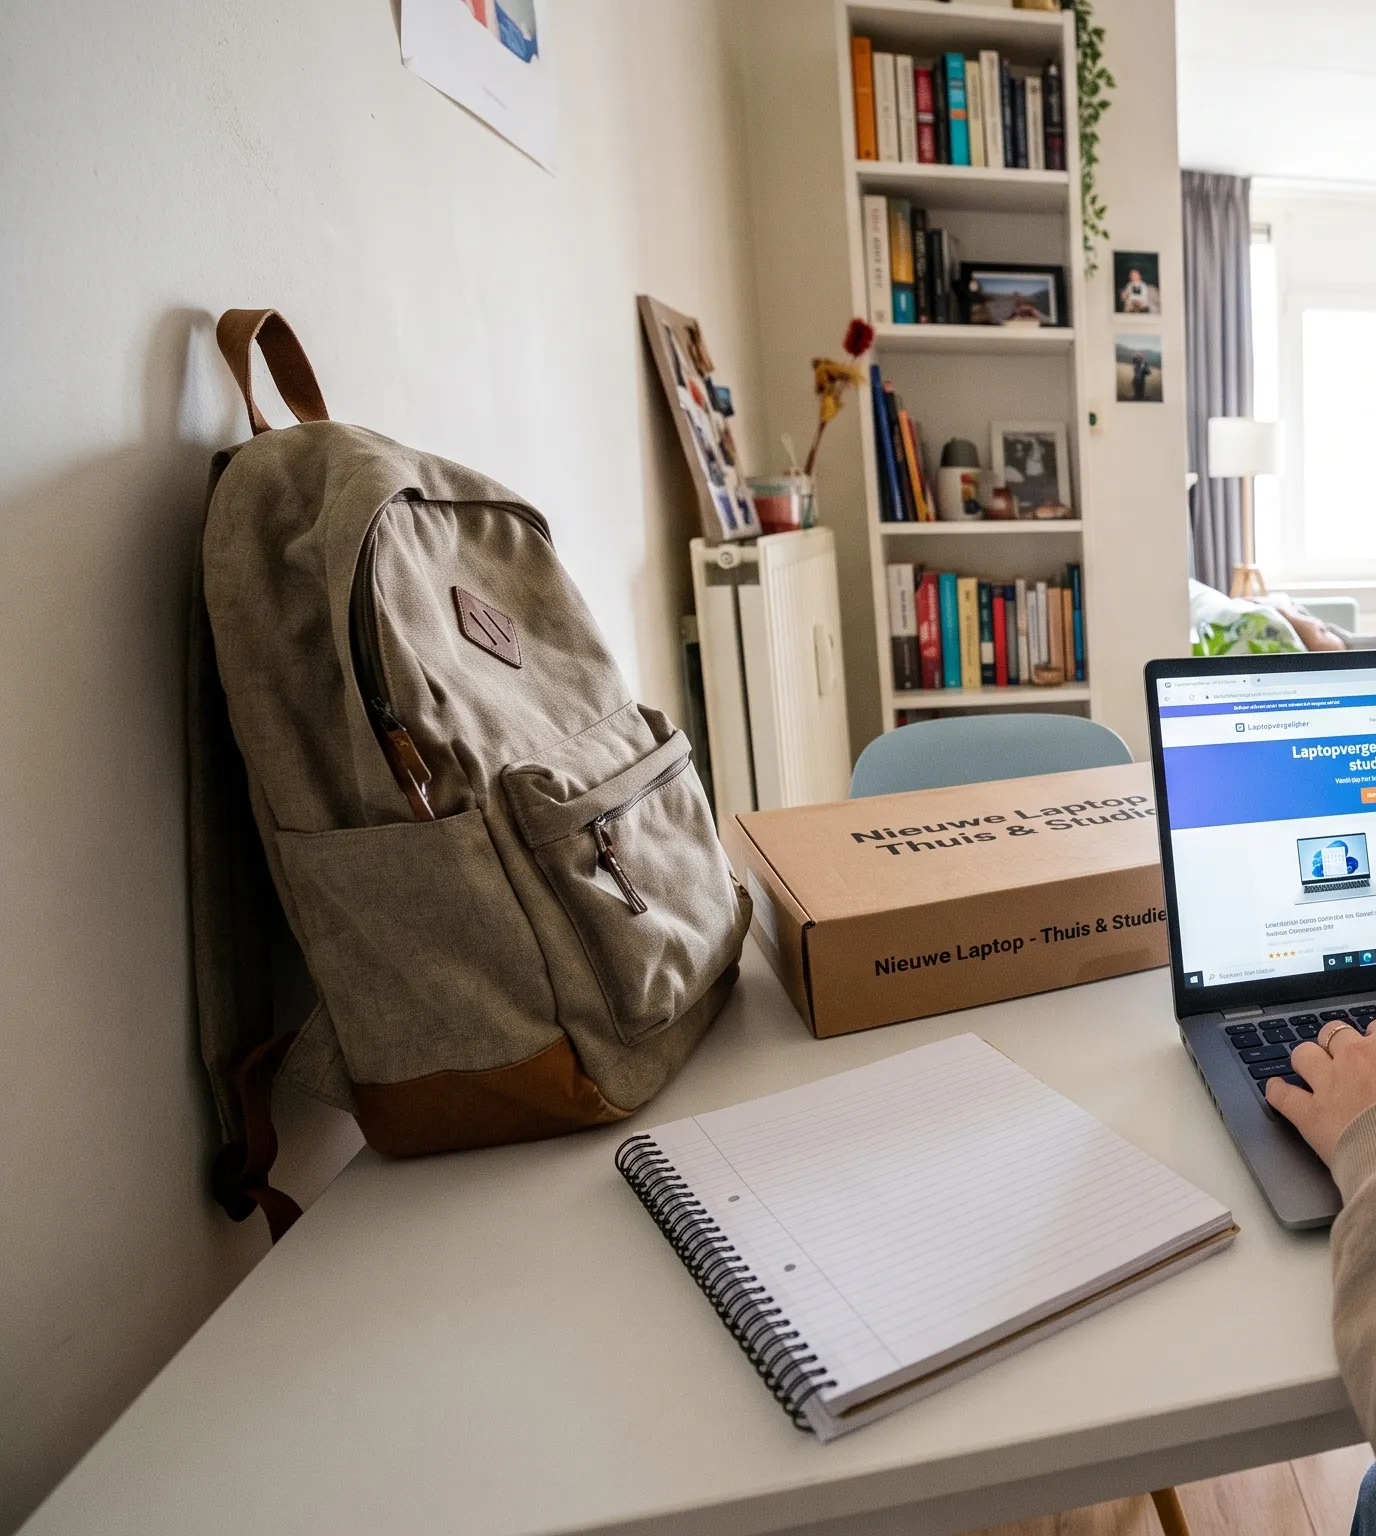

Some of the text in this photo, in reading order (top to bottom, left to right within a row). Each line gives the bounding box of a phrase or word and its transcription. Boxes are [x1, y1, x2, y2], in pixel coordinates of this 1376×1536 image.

[850, 795, 1148, 844] Nieuwe Laptop
[875, 830, 997, 856] Thuis
[1006, 825, 1039, 837] &
[874, 948, 951, 977] Nieuwe
[957, 936, 1024, 961] Laptop
[1040, 921, 1091, 944] Thuis
[1095, 917, 1108, 933] &
[1112, 907, 1167, 930] Studie
